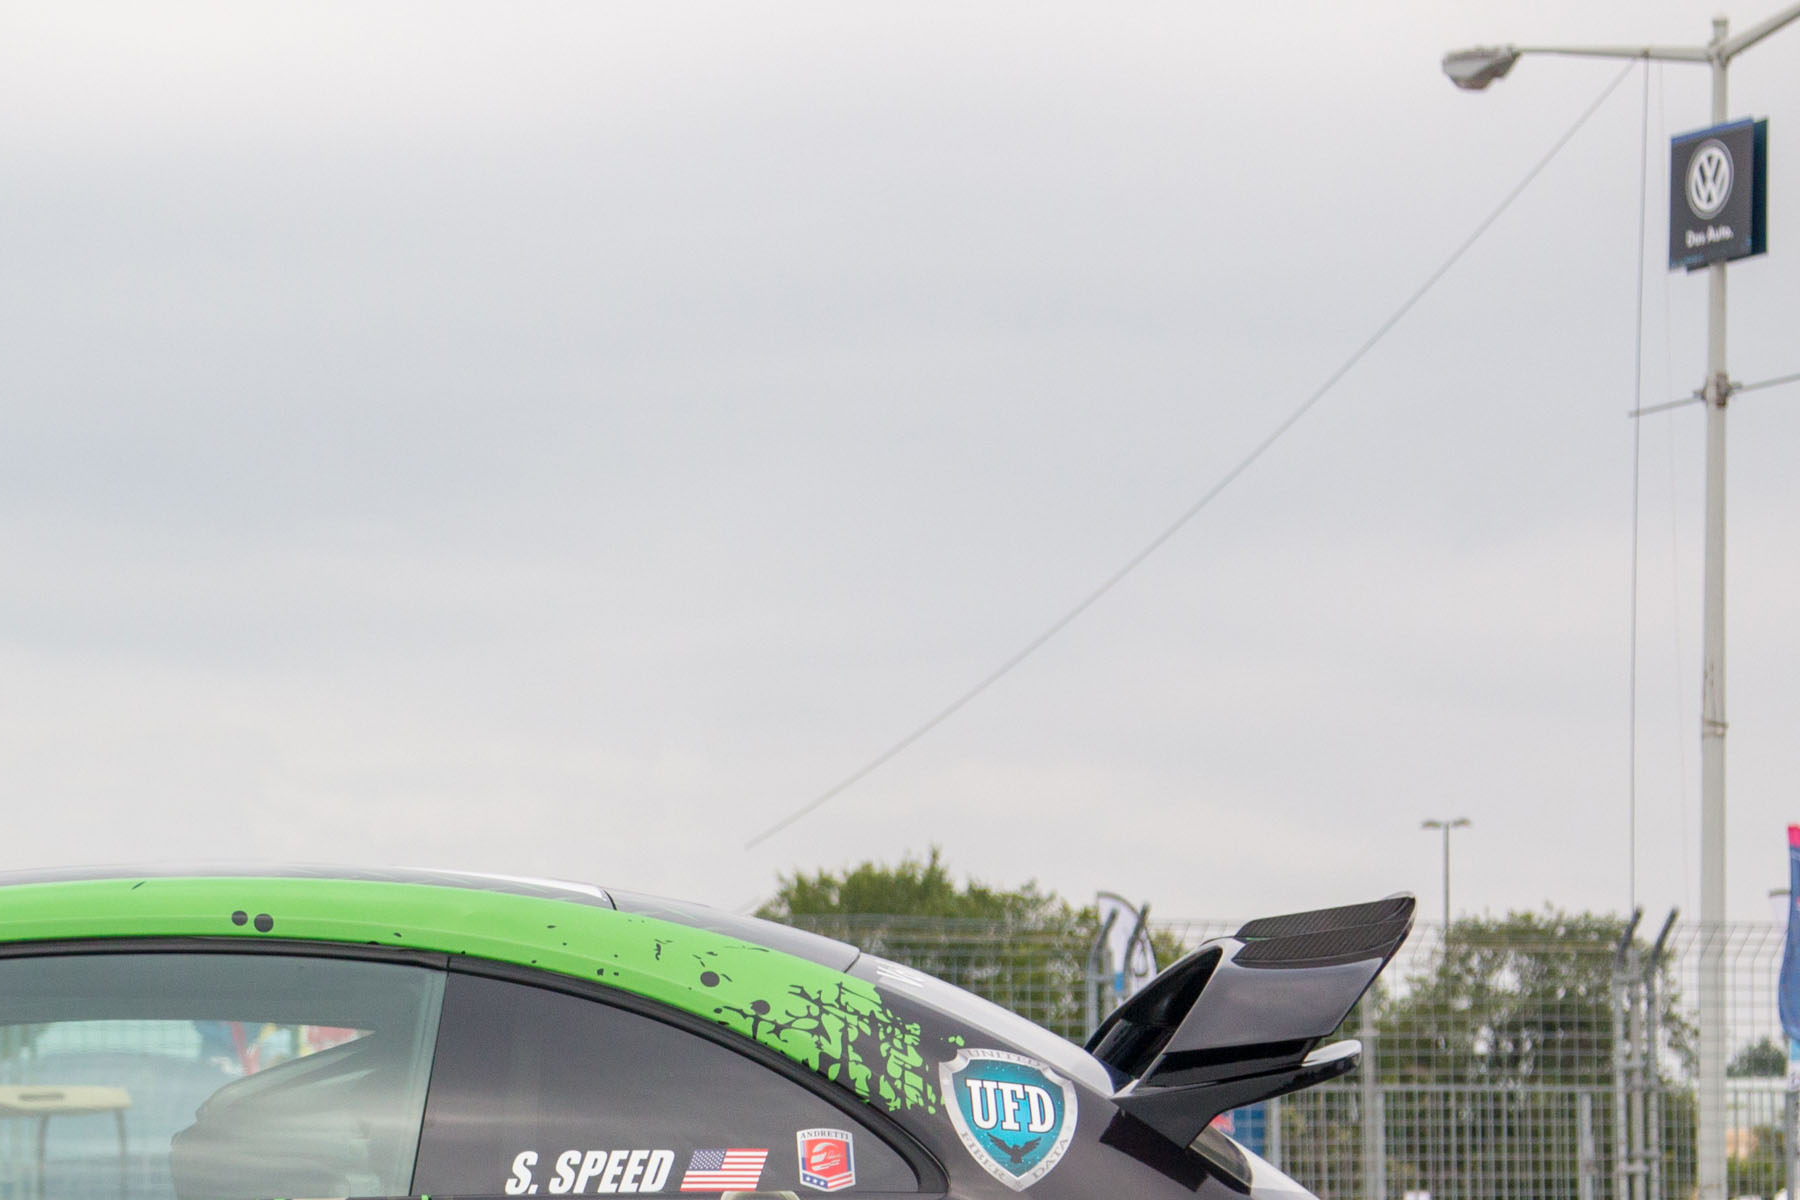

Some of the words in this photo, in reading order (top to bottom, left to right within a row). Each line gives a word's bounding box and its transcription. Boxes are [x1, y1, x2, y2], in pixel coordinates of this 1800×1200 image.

[966, 1078, 1055, 1133] UFD
[800, 1130, 850, 1140] ANDRETTI
[962, 1131, 1005, 1181] FIBER
[1032, 1138, 1069, 1180] DATA
[505, 1151, 539, 1195] S.
[549, 1150, 675, 1194] SPEED
